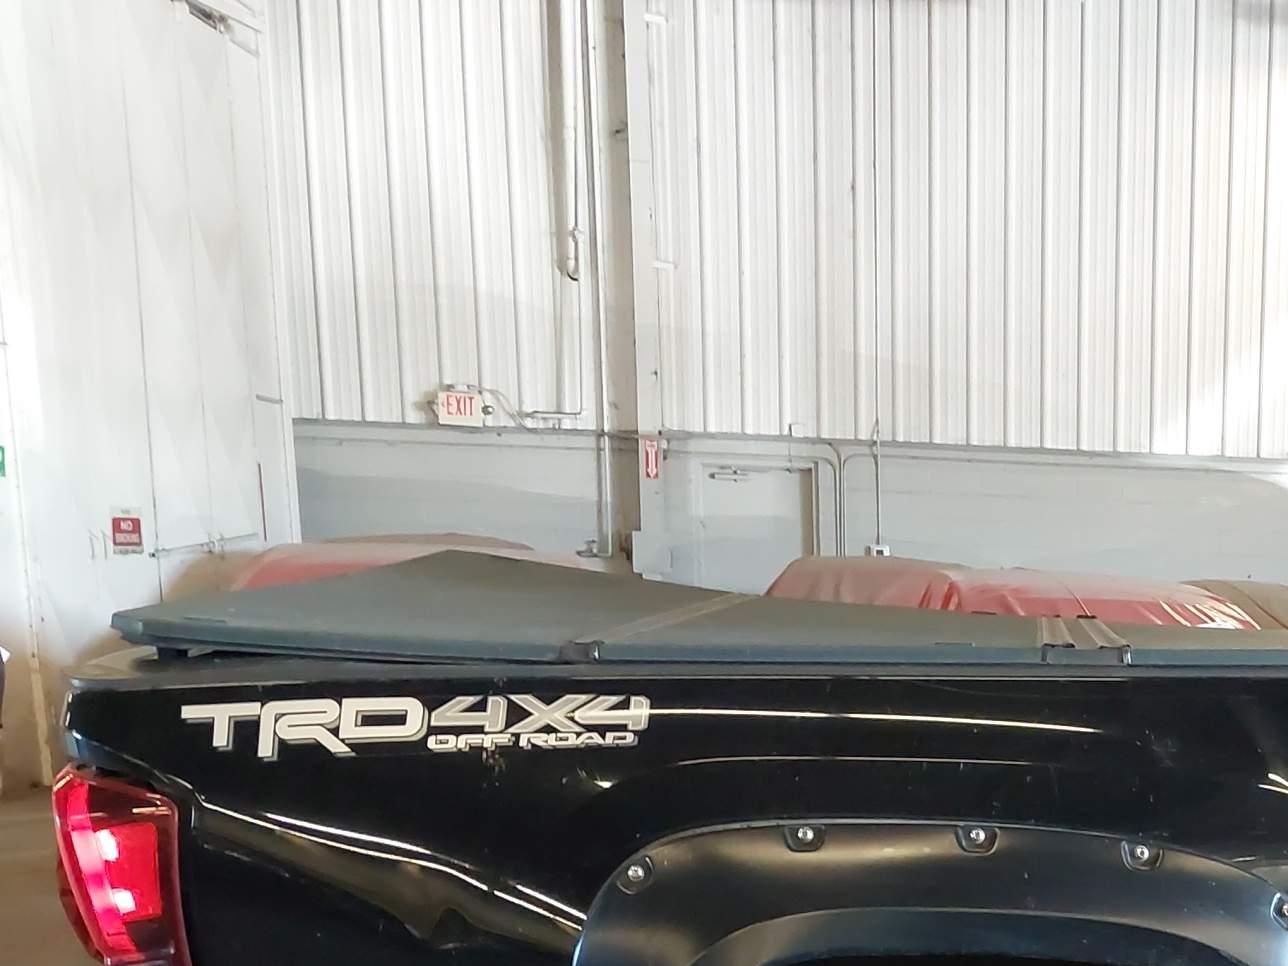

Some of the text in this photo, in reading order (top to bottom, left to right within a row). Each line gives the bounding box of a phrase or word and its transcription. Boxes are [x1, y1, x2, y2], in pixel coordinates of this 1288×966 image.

[446, 394, 475, 416] EXIT
[181, 693, 650, 761] TRD 4X4
[427, 731, 637, 752] OFF ROAD
